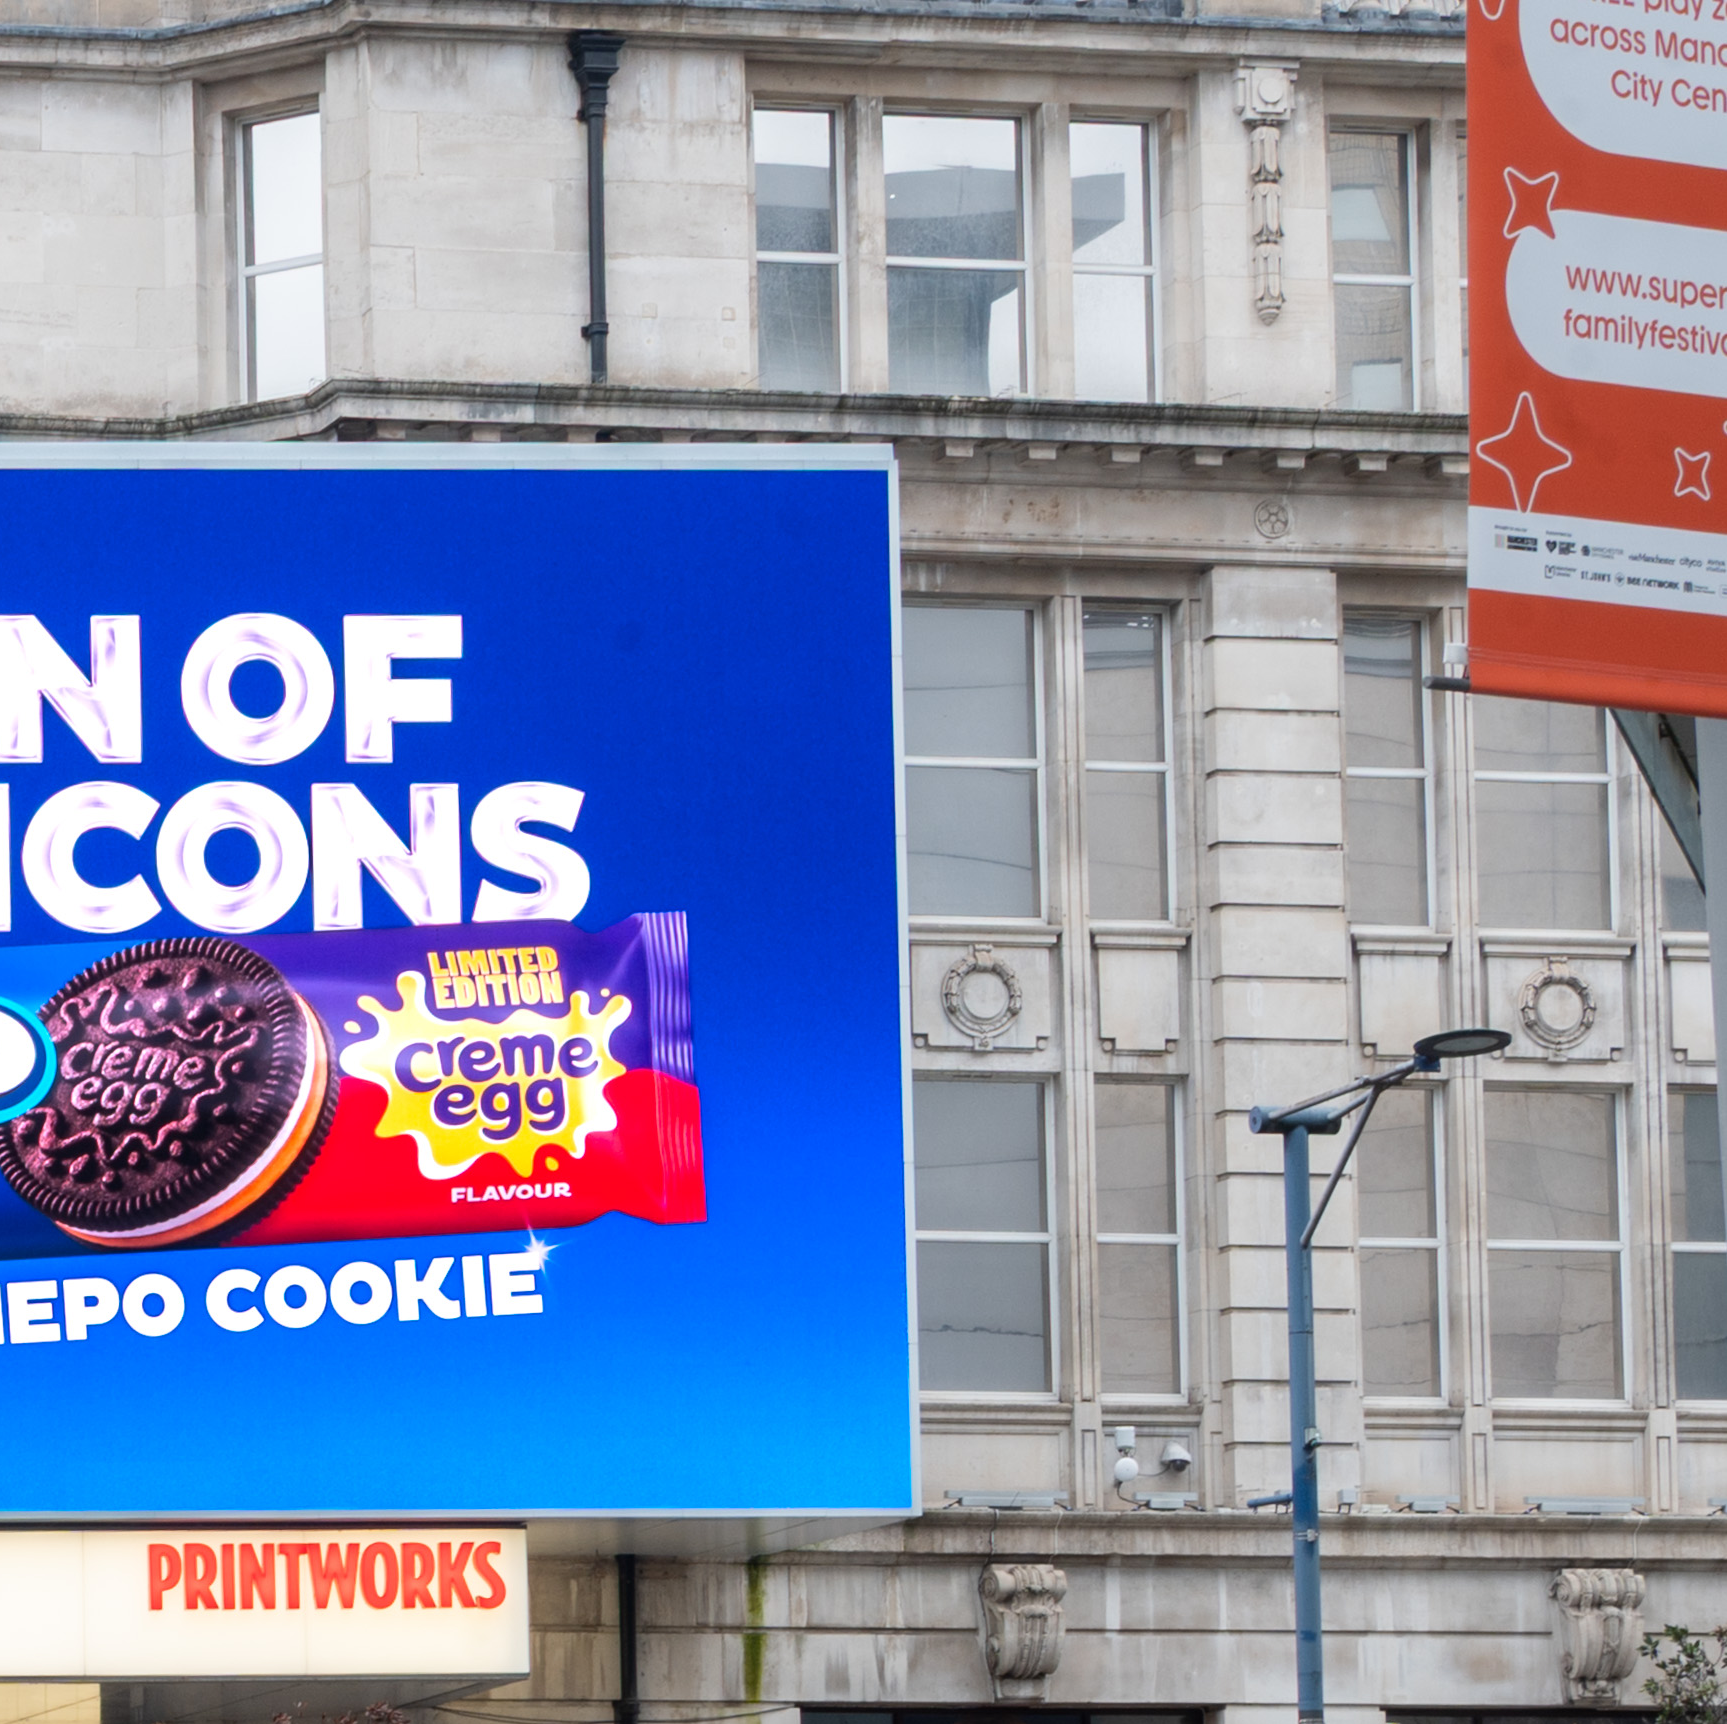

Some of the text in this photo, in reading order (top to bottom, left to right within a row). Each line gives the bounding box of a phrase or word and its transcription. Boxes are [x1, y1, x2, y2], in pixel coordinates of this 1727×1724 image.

[1550, 18, 1647, 55] across
[1611, 70, 1727, 113] City Cen
[1565, 265, 1727, 309] www.super
[180, 611, 464, 766] OF
[427, 946, 558, 978] LIMITED
[432, 972, 564, 1009] EDITION
[60, 1041, 207, 1090] creme
[395, 1034, 599, 1093] creme
[71, 1077, 171, 1126] egg
[434, 1078, 565, 1141] egg
[451, 1182, 572, 1203] FLAVOUR
[204, 1254, 544, 1332] COOKIE
[148, 1541, 507, 1611] PRINTWORKS
